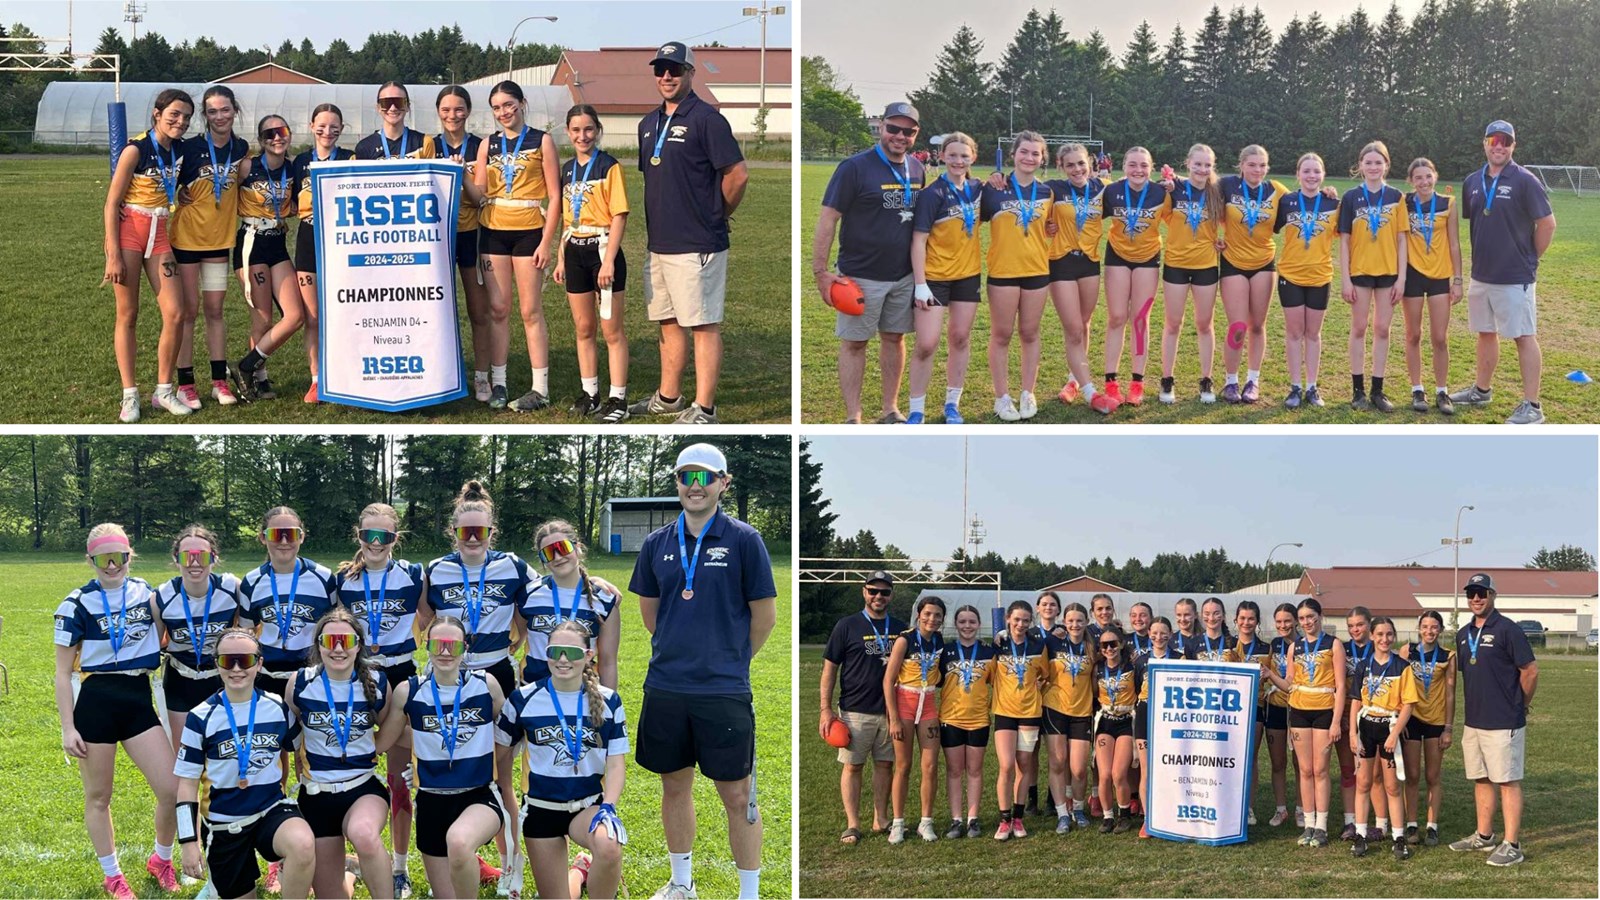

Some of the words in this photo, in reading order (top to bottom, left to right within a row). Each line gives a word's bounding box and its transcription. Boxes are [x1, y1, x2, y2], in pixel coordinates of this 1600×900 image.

[334, 193, 442, 227] RSEQ
[336, 231, 369, 245] FLAG
[373, 229, 441, 244] FOOTBALL
[364, 254, 415, 265] 2024-2025
[162, 261, 179, 277] 32
[254, 272, 266, 286] 15
[300, 275, 313, 286] 28
[337, 286, 444, 303] CHAMPIONNES
[362, 318, 407, 328] BENJAMIN
[409, 317, 421, 327] D4
[373, 335, 403, 345] Niveau
[405, 334, 411, 344] 3
[362, 355, 425, 374] RSEQ
[1163, 686, 1243, 712] RSEQ
[1162, 712, 1188, 723] FLAG
[1190, 713, 1239, 726] FOOTBALL
[1182, 730, 1218, 740] 2024-2025
[1162, 753, 1236, 769] CHAMPIONNES
[1178, 776, 1208, 785] BENJAMIN
[1209, 778, 1217, 786] D4
[1185, 789, 1205, 798] Niveau
[1177, 805, 1217, 821] RSEQ
